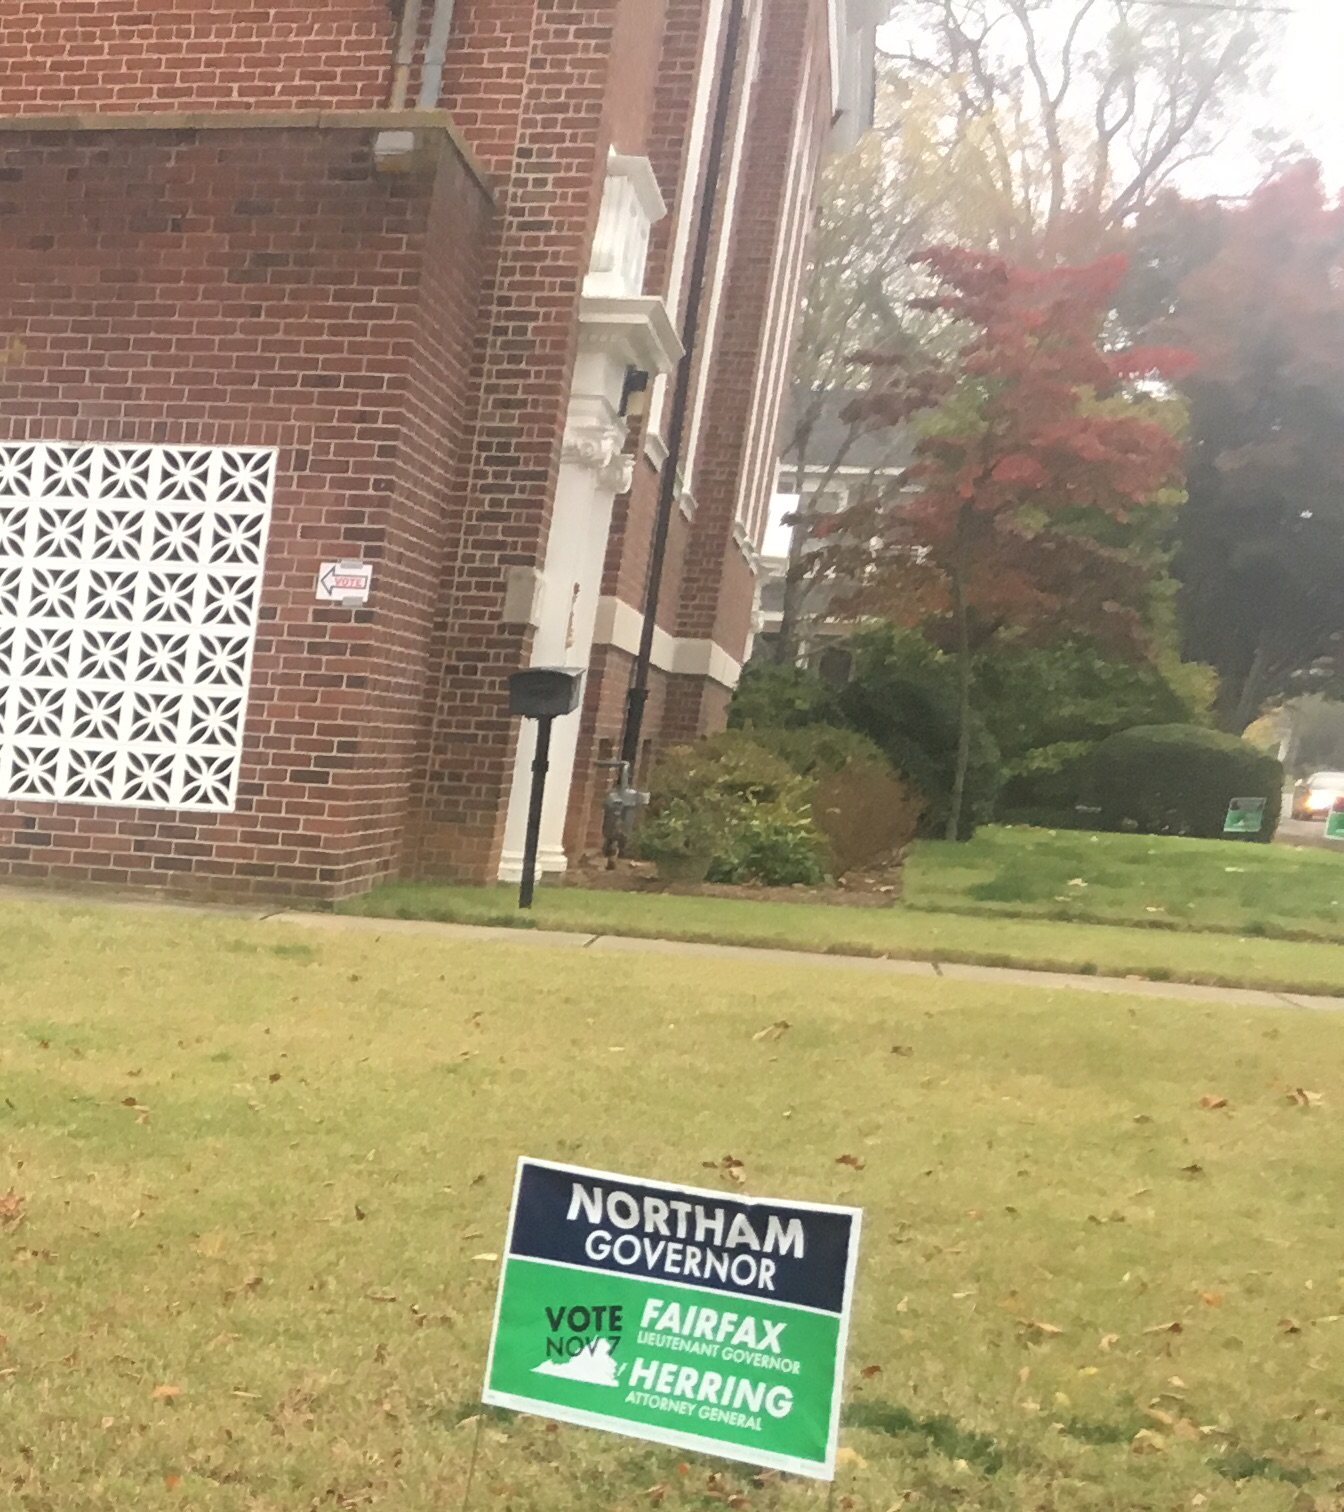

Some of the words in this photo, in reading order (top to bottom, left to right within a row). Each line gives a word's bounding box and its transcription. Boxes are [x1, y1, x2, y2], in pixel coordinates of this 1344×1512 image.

[335, 577, 362, 587] VOTE
[565, 1182, 806, 1259] NORTHAM
[584, 1229, 777, 1291] GOVERNOR
[544, 1304, 624, 1333] VOTE
[639, 1298, 787, 1354] FAIRFAX
[545, 1335, 601, 1358] NOV
[607, 1336, 622, 1358] 7
[636, 1330, 719, 1358] LIEUTENANT
[721, 1346, 801, 1375] GOVERNOR
[624, 1390, 696, 1417] ATTORNEY
[697, 1404, 762, 1431] GENERAL
[628, 1357, 794, 1419] HERRING
